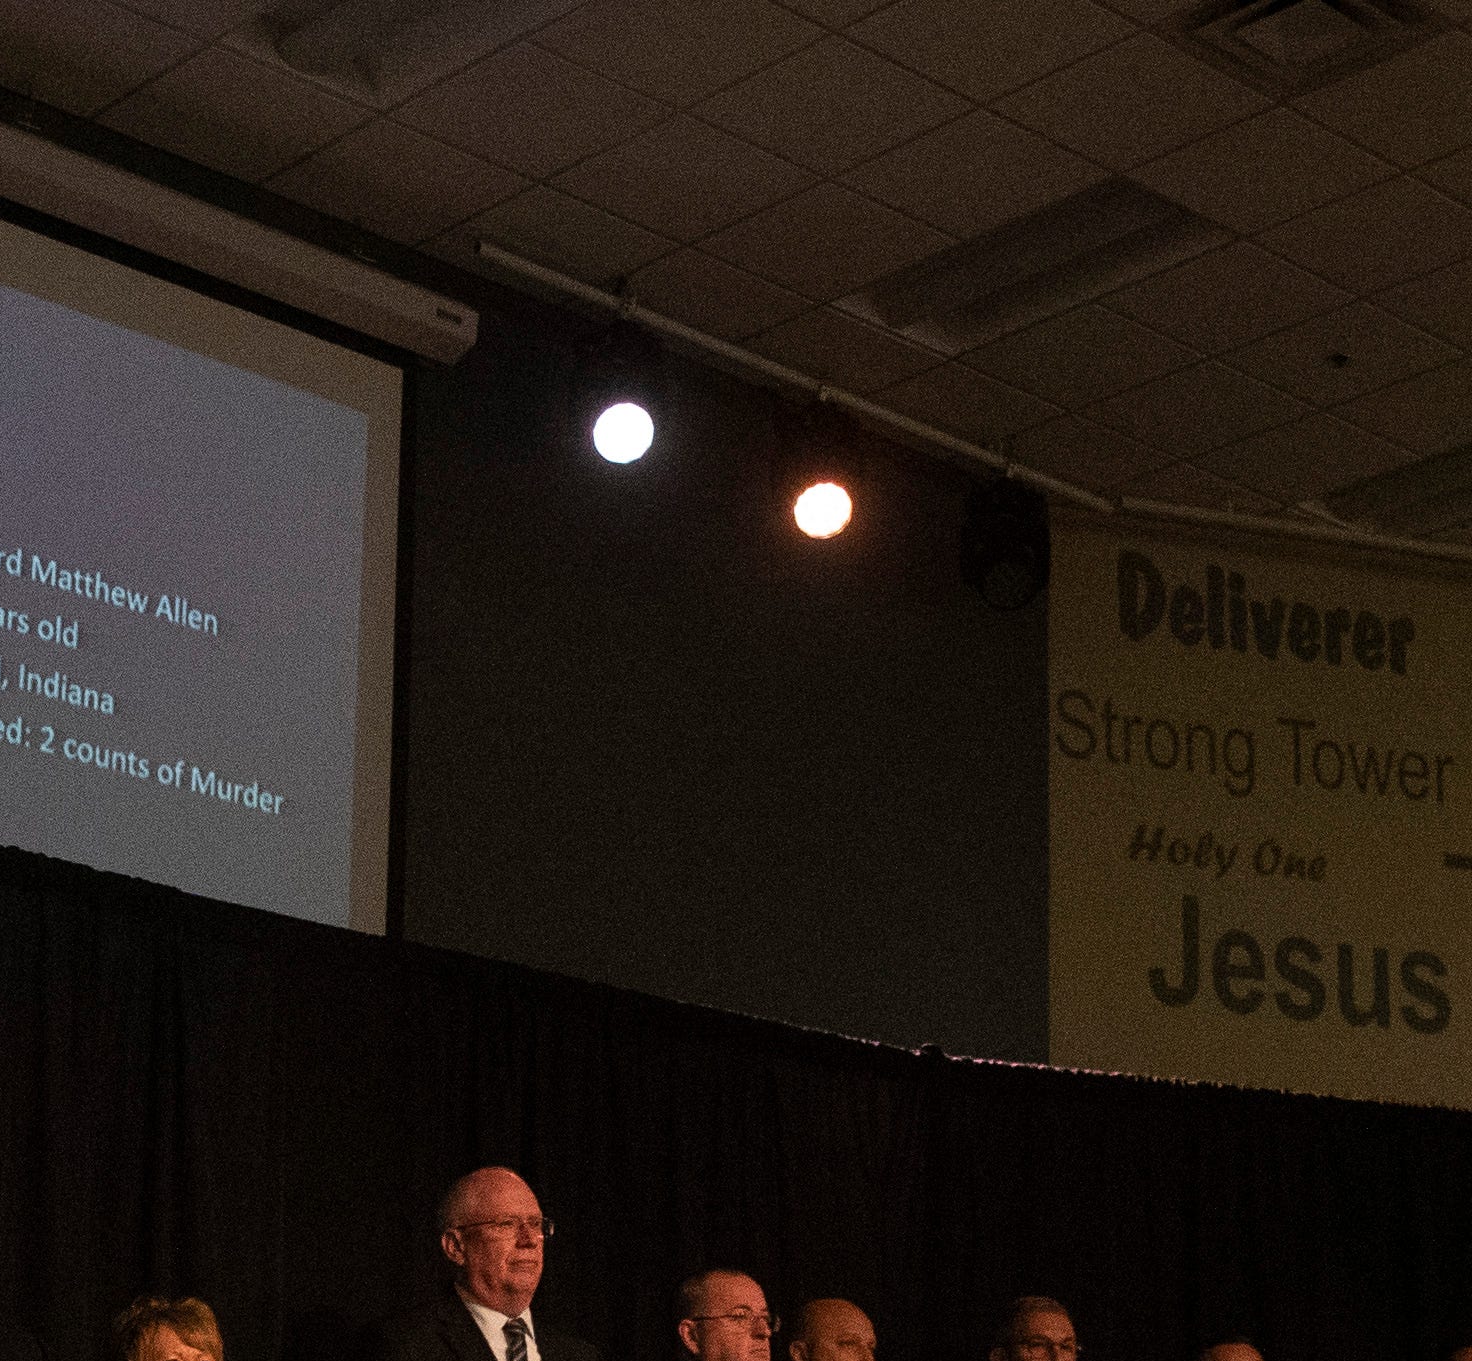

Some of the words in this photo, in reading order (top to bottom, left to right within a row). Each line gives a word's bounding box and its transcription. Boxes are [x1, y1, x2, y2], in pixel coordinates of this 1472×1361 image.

[31, 554, 148, 615] Matthew
[155, 594, 218, 636] Allen
[37, 614, 79, 649] old
[1117, 549, 1415, 674] Deliverer
[18, 662, 115, 716] Indiana
[39, 726, 56, 754] 2
[63, 738, 149, 779] counts
[157, 760, 187, 788] of
[192, 766, 284, 815] Murder
[1055, 689, 1256, 798] Strong
[1276, 716, 1454, 804] Tower
[1129, 824, 1239, 877] Holy
[1253, 838, 1327, 882] One
[1148, 895, 1452, 1034] Jesus
